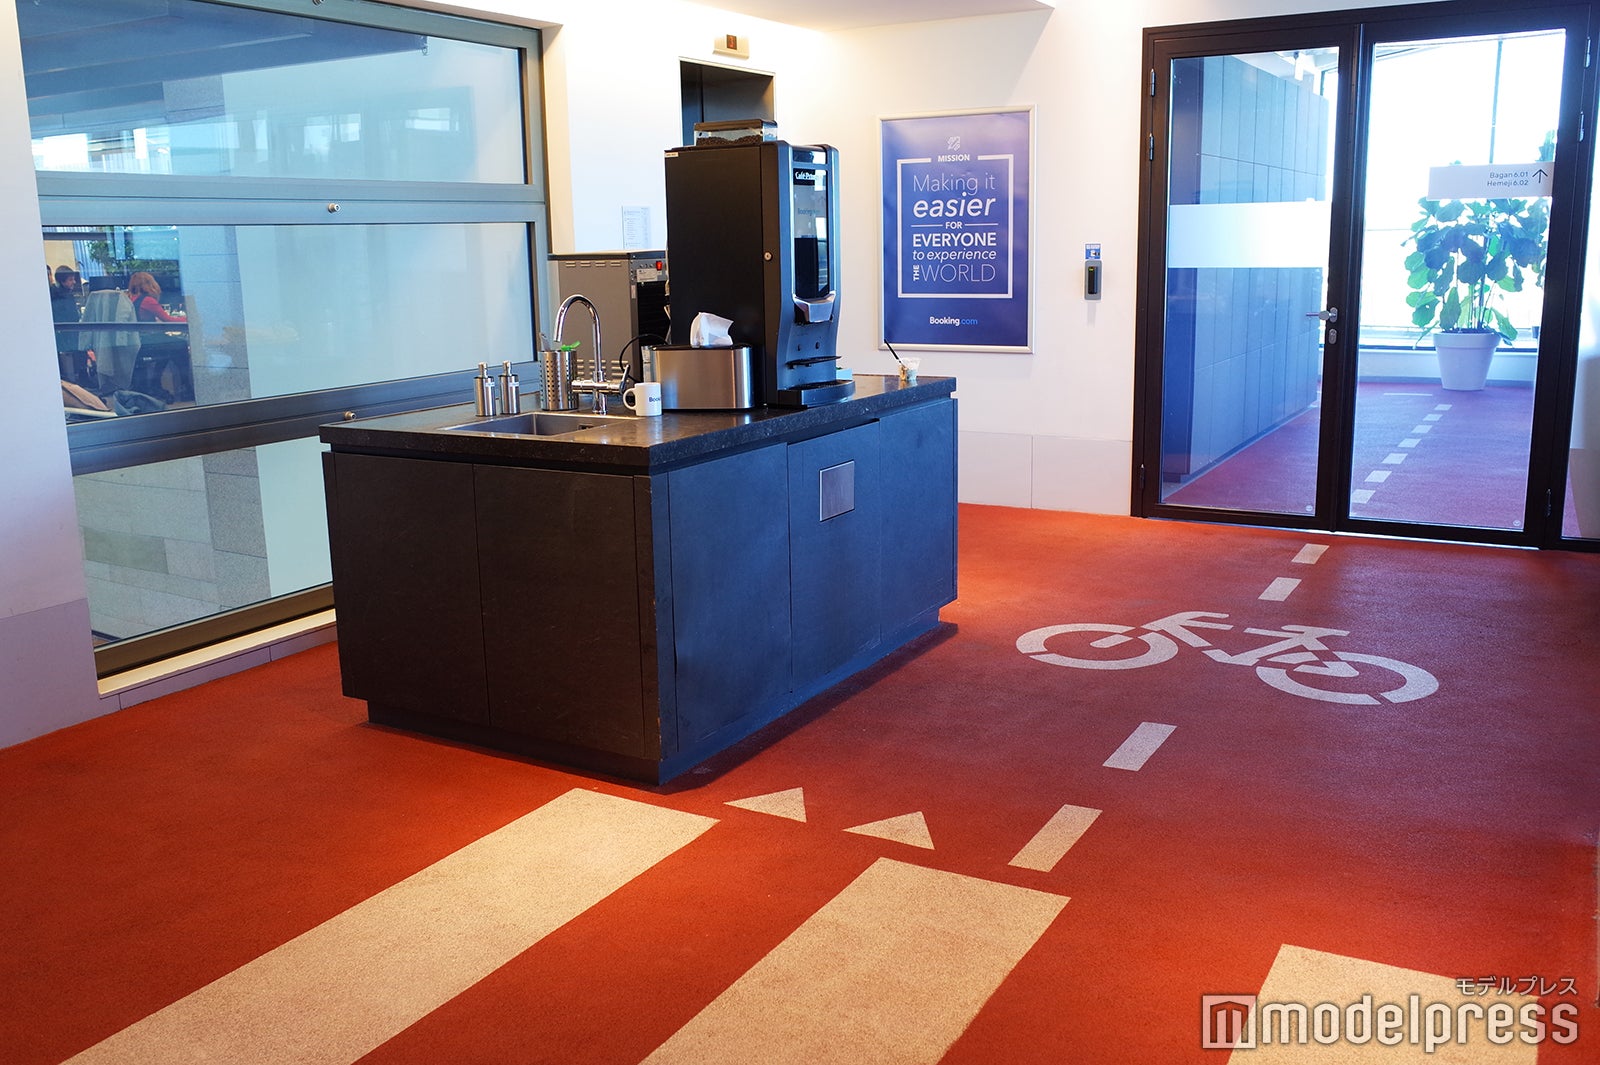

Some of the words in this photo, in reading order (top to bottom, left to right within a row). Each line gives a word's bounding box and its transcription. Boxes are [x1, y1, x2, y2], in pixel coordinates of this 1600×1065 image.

[938, 154, 970, 162] MISSION
[913, 173, 978, 196] Making
[985, 172, 996, 190] it
[913, 191, 996, 218] easier
[945, 221, 963, 230] FOR
[912, 232, 997, 247] EVERYONE
[912, 249, 925, 261] to
[927, 247, 997, 263] experience
[920, 263, 996, 282] WORLD
[929, 316, 979, 326] Booking.com
